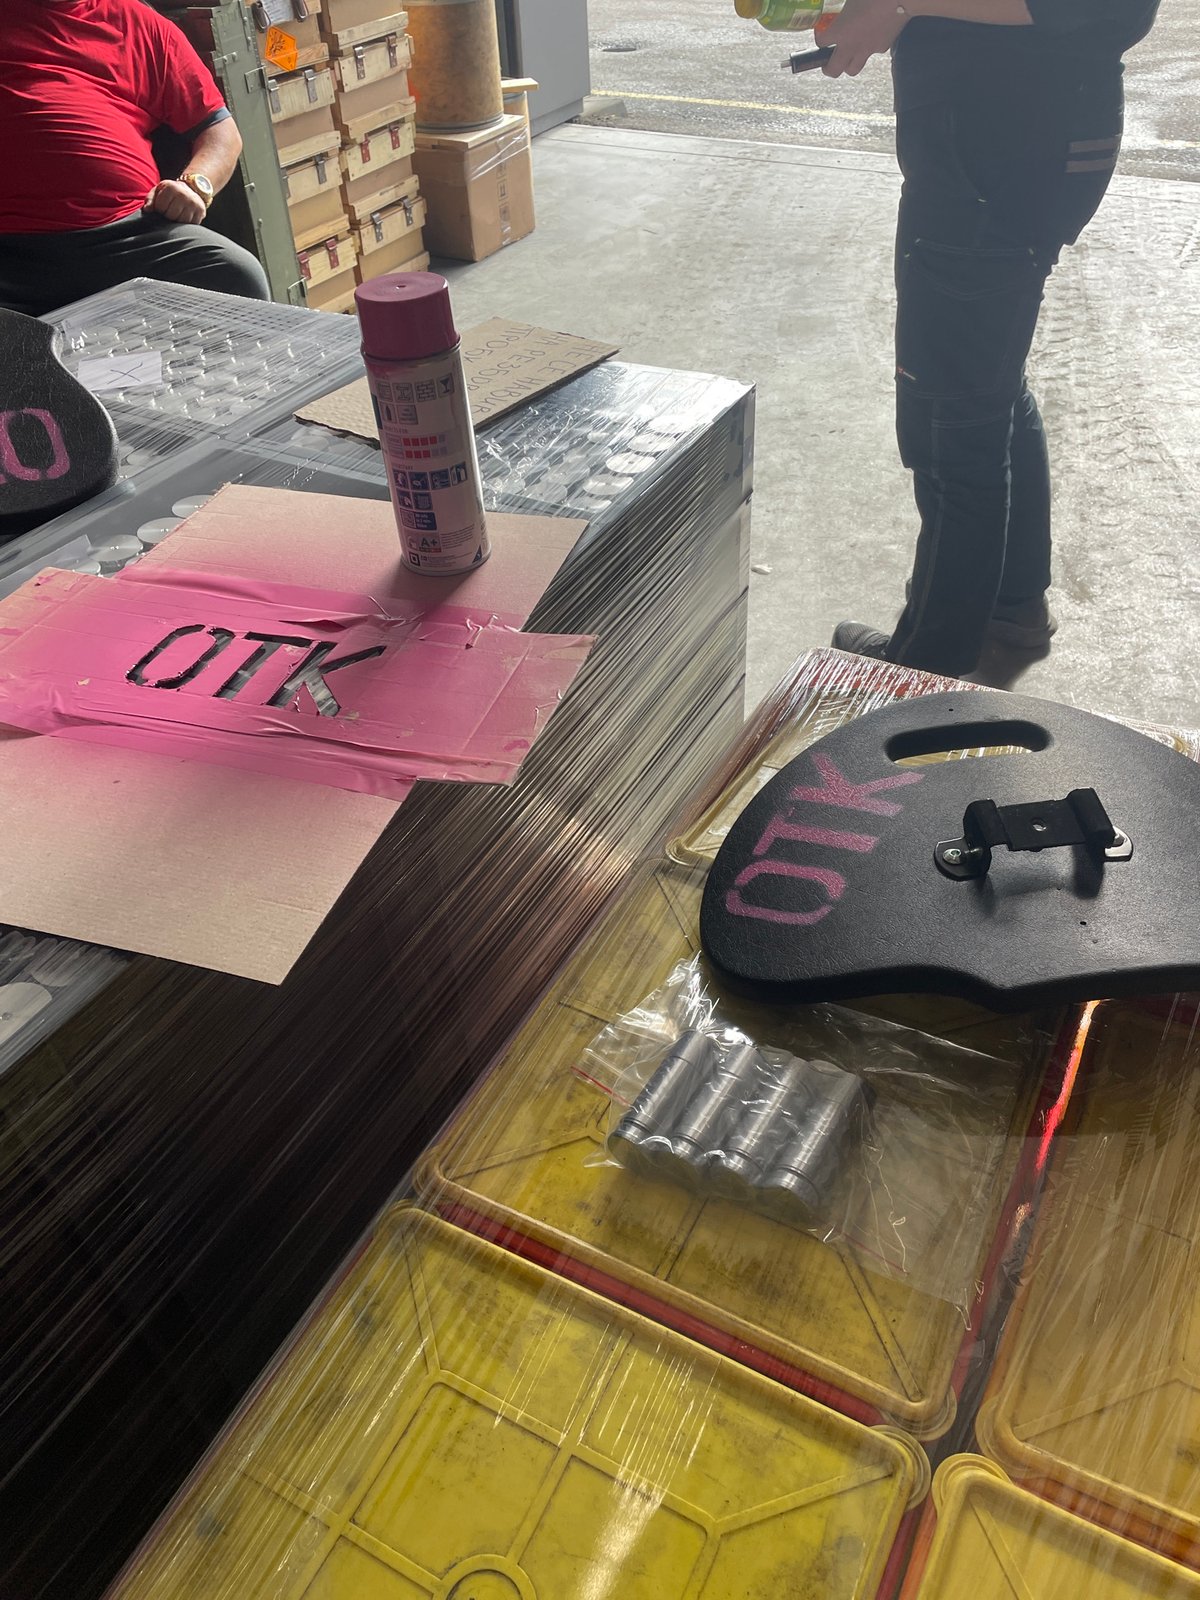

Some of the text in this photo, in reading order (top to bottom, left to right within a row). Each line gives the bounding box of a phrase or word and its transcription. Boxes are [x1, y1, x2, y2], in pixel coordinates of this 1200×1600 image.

[535, 333, 569, 346] НА
[537, 360, 577, 374] СЕ
[471, 376, 546, 414] НАВИВ
